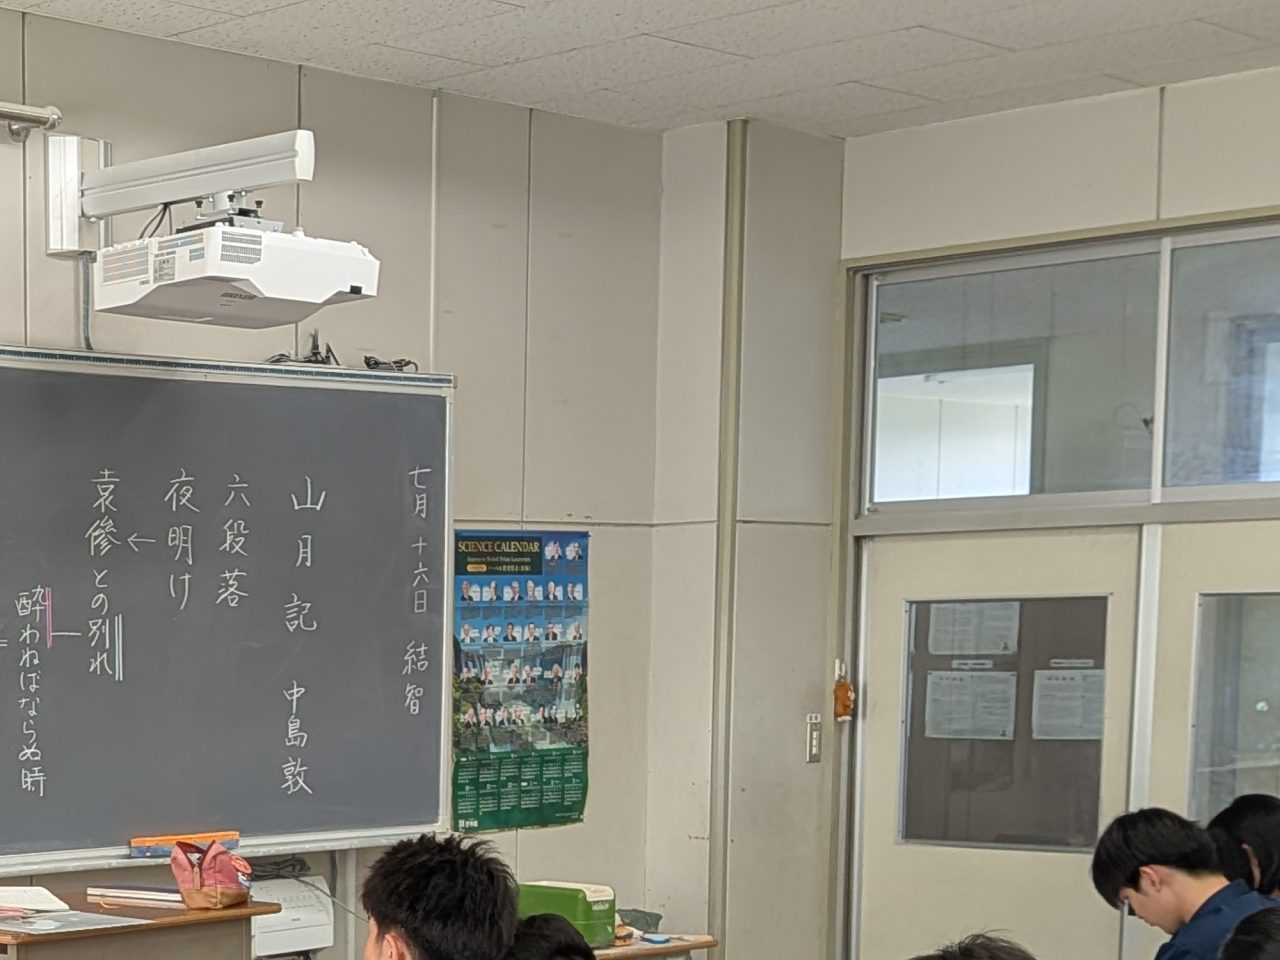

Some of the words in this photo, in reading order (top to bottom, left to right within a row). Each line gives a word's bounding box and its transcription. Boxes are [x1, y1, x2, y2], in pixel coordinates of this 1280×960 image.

[164, 467, 201, 611] 夜明け
[216, 474, 251, 607] 六段落
[282, 475, 327, 632] 山月記
[458, 541, 493, 552] SCIENCE
[494, 541, 540, 552] CALENDAR
[15, 584, 48, 797] 酔わねばならぬ時
[280, 680, 313, 795] 中島敦
